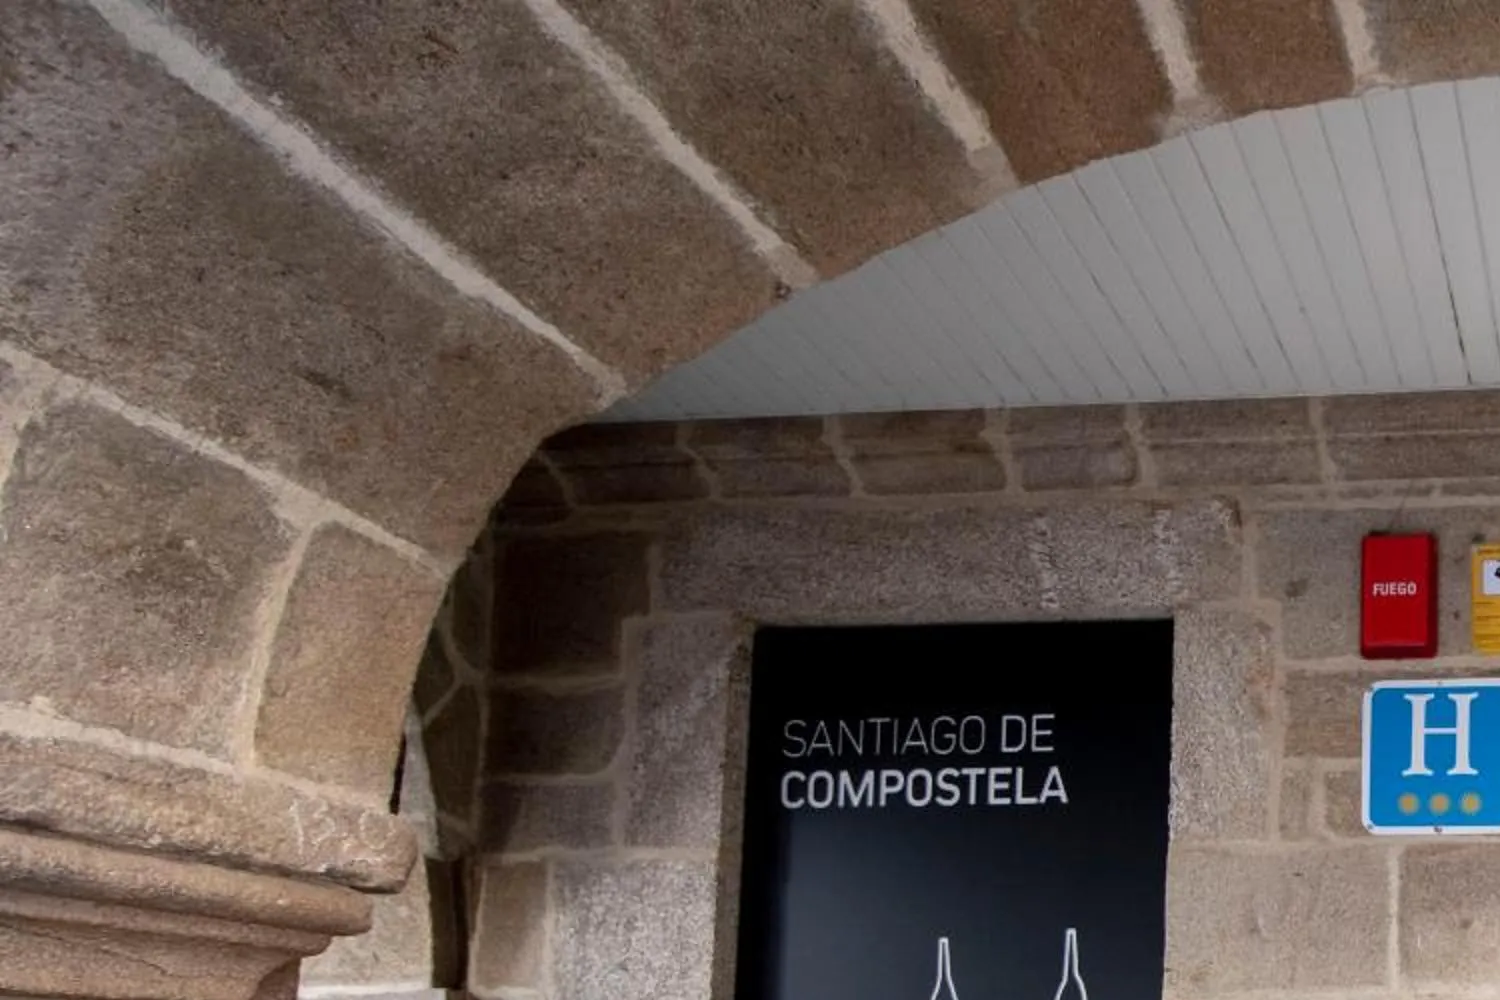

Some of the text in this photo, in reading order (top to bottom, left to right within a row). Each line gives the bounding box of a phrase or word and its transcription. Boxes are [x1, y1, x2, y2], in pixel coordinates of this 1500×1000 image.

[1372, 581, 1418, 597] FUEGO
[781, 713, 1056, 758] SANTIAGO DE
[1401, 692, 1480, 777] H
[780, 765, 1069, 809] COMPOSTELA
